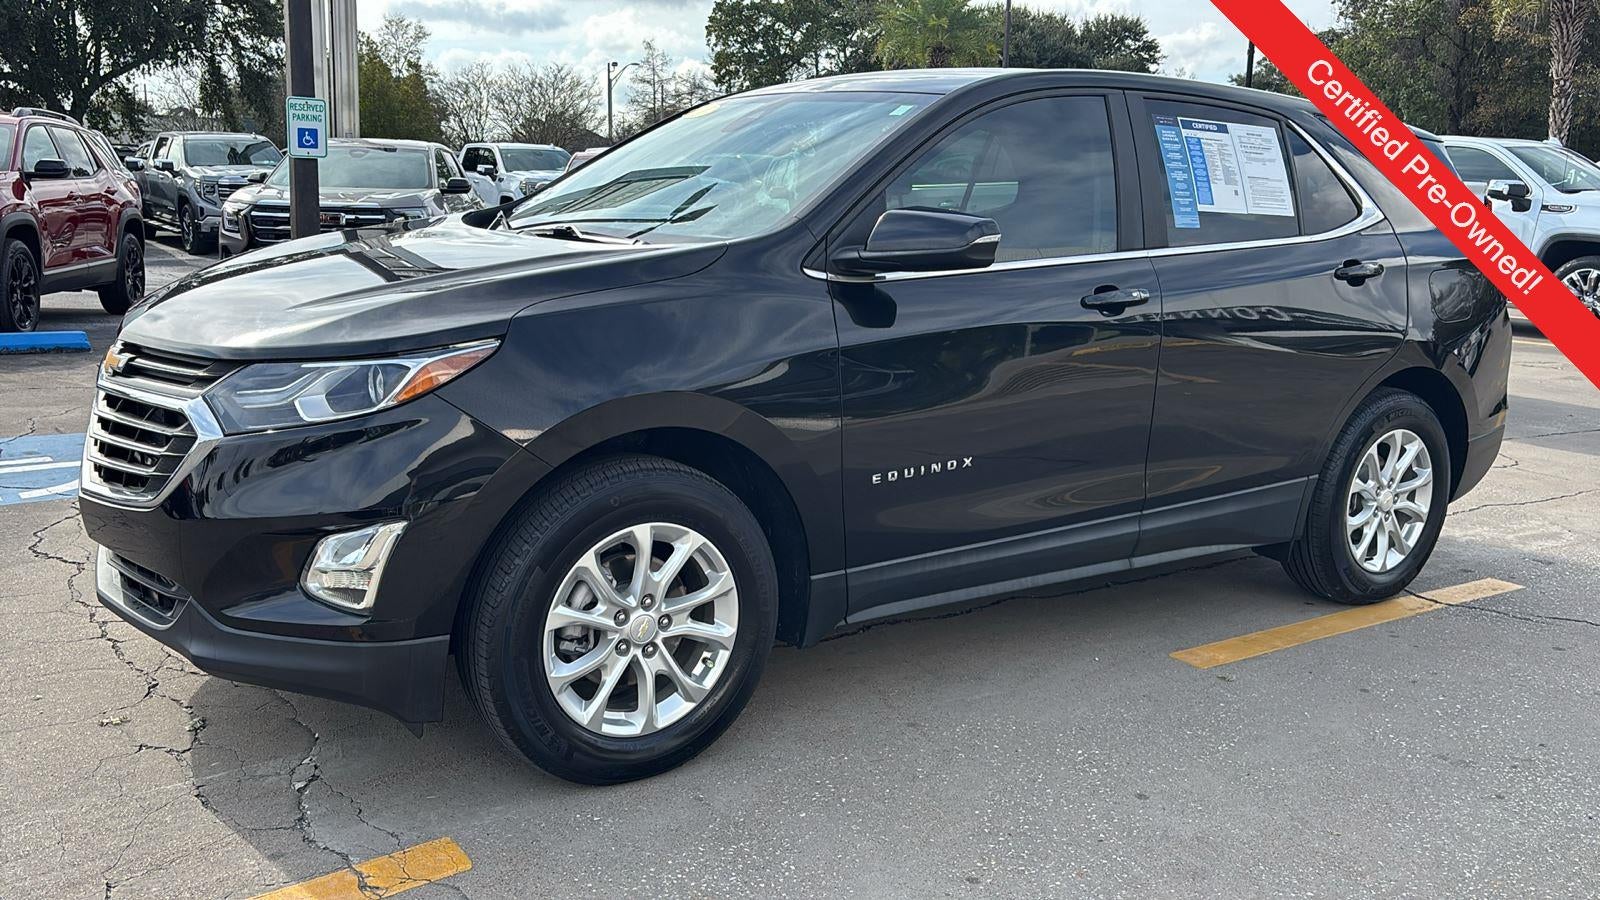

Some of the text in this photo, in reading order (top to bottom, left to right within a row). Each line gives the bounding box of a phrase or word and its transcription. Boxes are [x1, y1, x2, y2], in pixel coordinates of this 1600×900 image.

[290, 103, 324, 113] RESERVED
[292, 113, 322, 123] PARKING
[1192, 122, 1218, 131] CERTIFIED
[872, 456, 973, 485] EQUINOX
